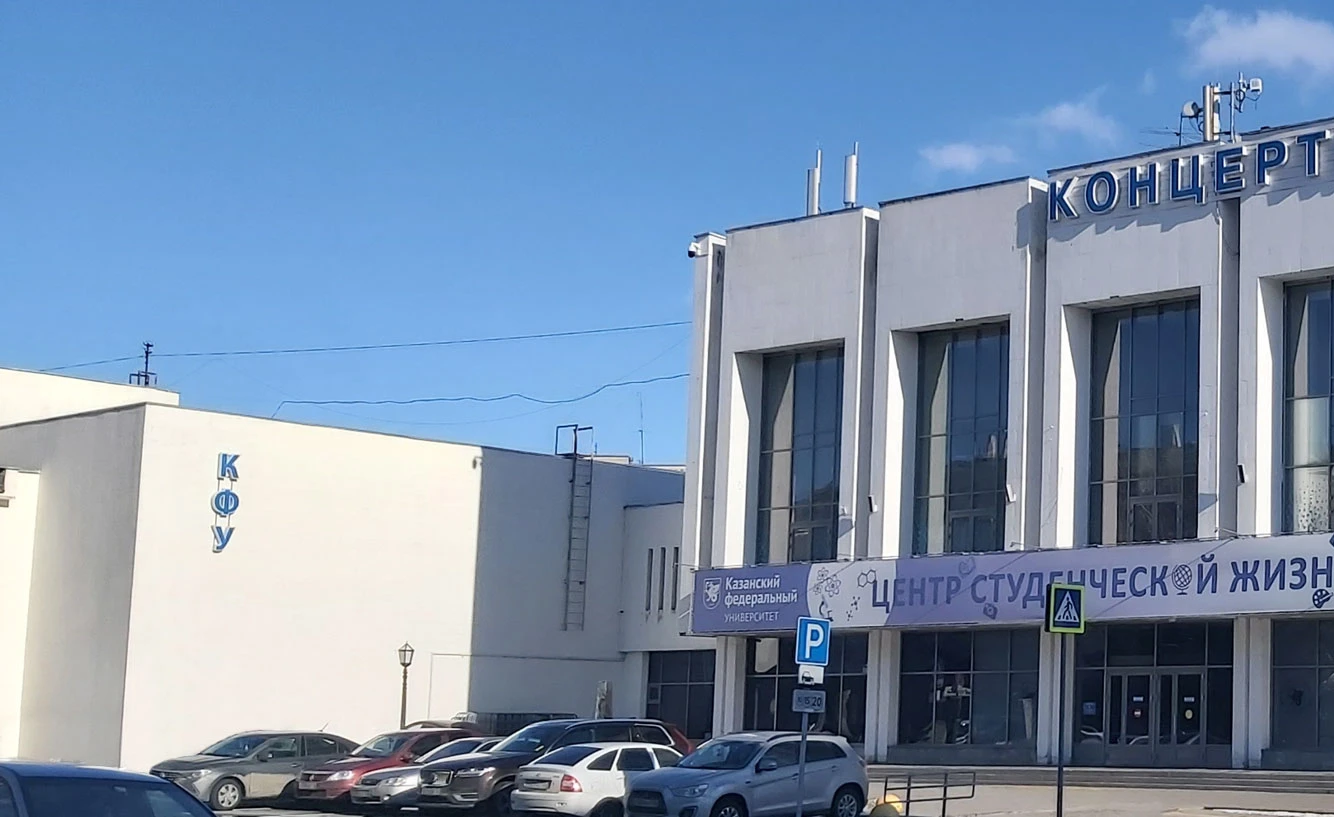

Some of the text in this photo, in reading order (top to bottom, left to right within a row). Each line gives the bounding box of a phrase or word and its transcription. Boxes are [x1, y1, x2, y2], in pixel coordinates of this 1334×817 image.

[724, 575, 781, 590] Казанский
[724, 589, 798, 607] федеральный
[872, 576, 962, 613] ЦЕНТР
[724, 611, 779, 623] УНИВЕРСИТЕТ
